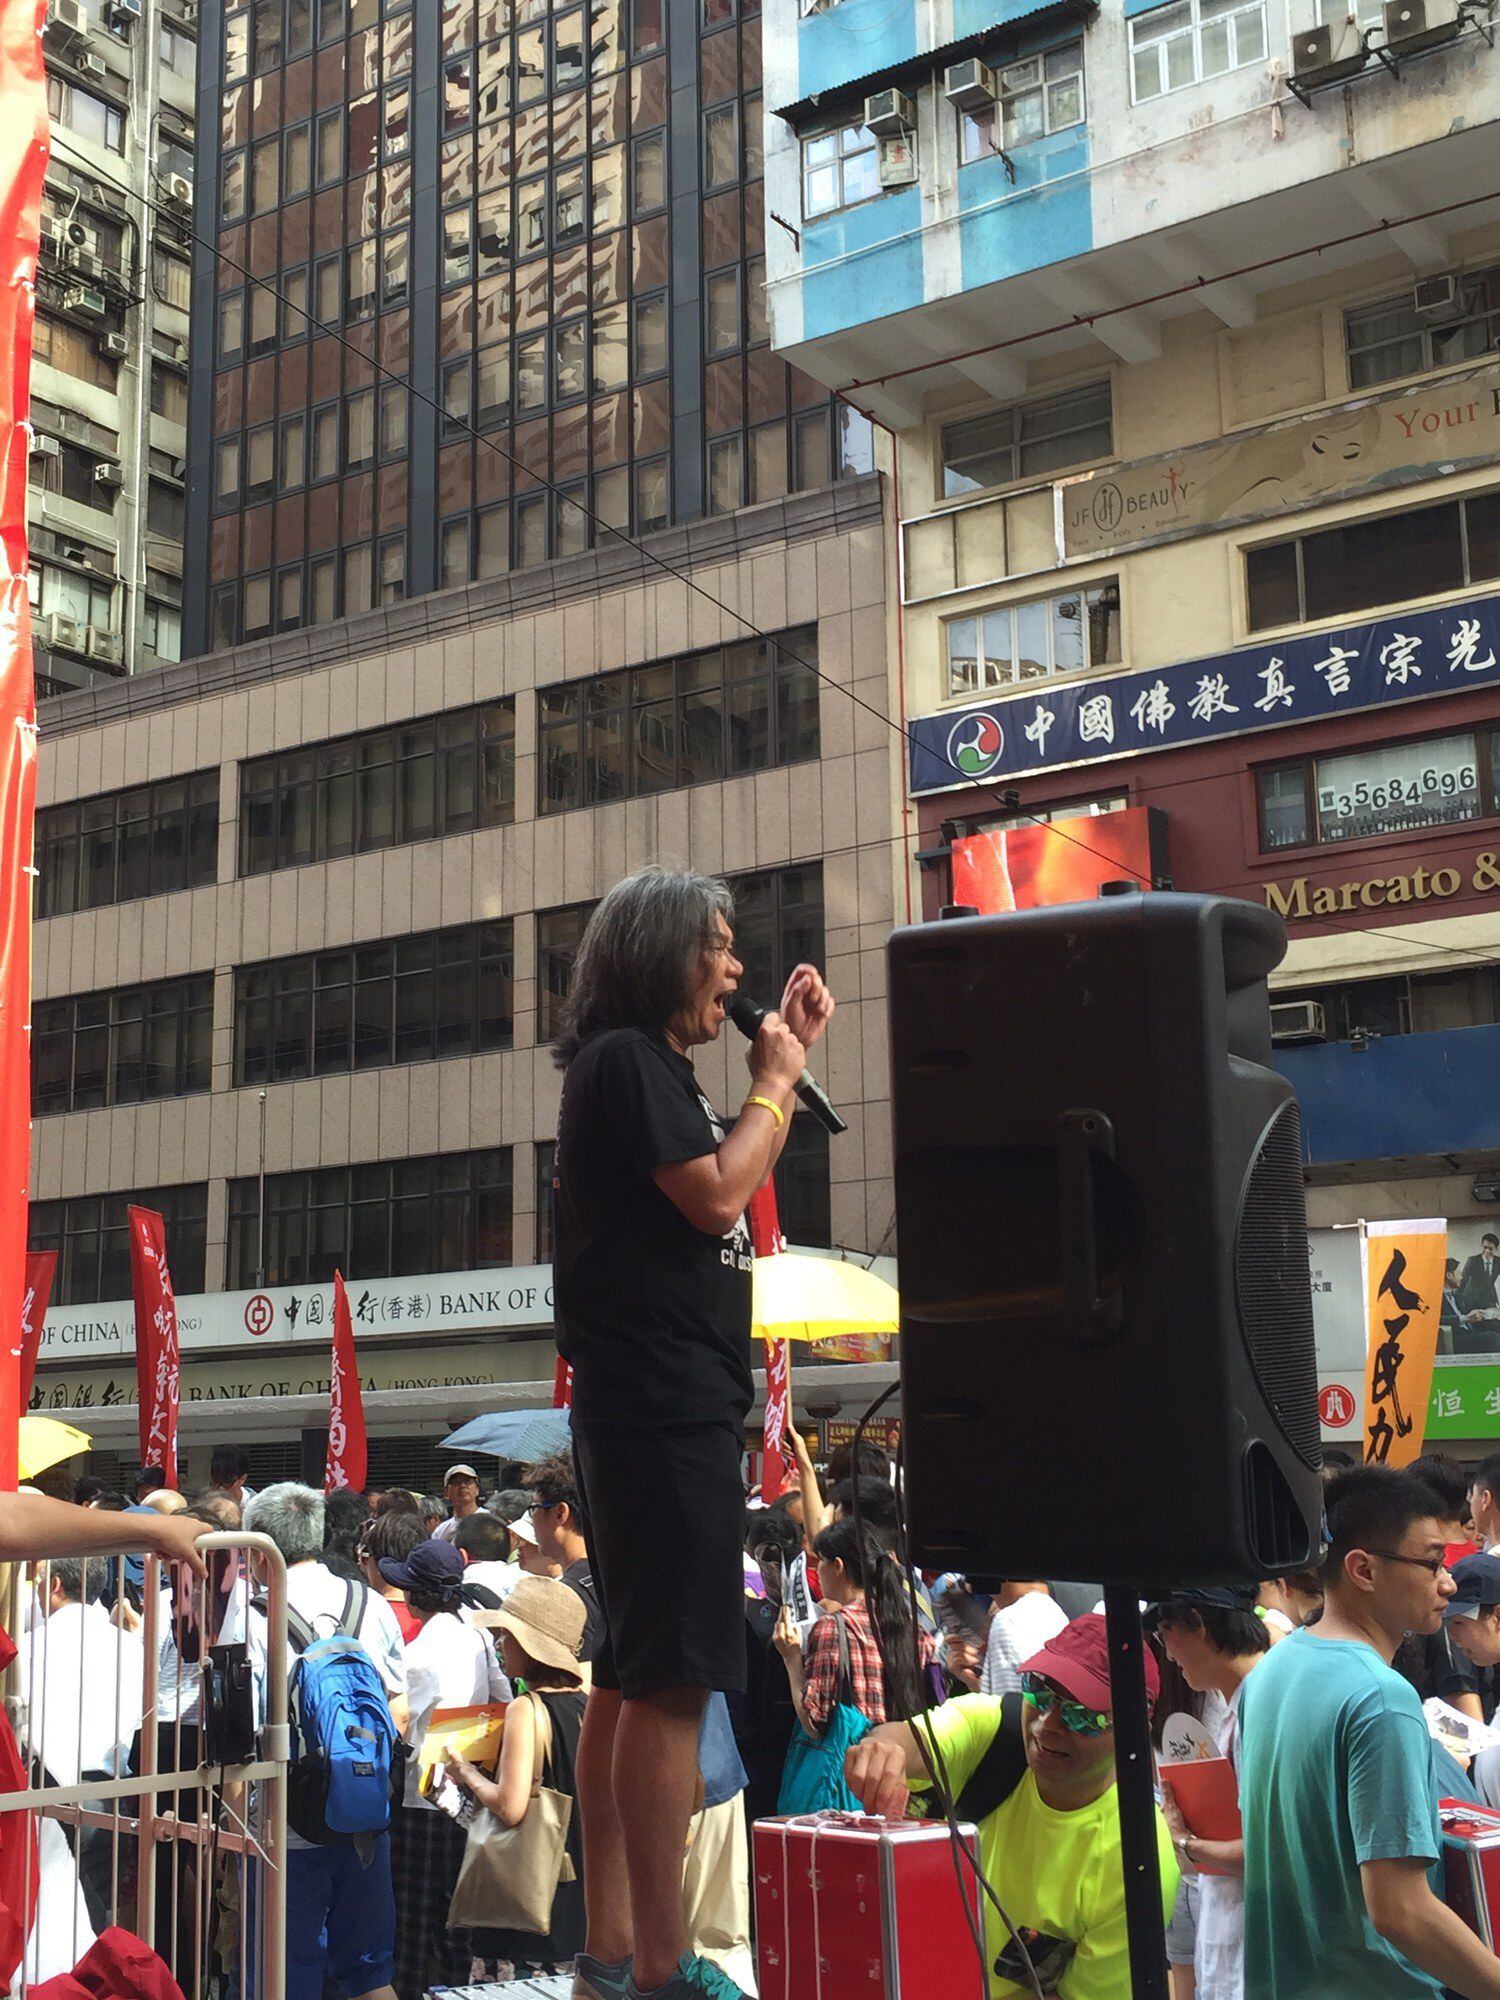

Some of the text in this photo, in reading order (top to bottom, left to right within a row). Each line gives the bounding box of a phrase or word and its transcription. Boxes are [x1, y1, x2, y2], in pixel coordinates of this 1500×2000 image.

[1393, 401, 1480, 439] Your
[1072, 508, 1090, 529] JF
[1337, 766, 1475, 816] 35684696
[1263, 852, 1500, 920] Marcato &
[284, 1289, 432, 1330] 中国行(香港)
[439, 1291, 501, 1316] BANK
[508, 1287, 537, 1310] OF
[61, 1321, 120, 1344] CHINA
[189, 1384, 253, 1402] BANK
